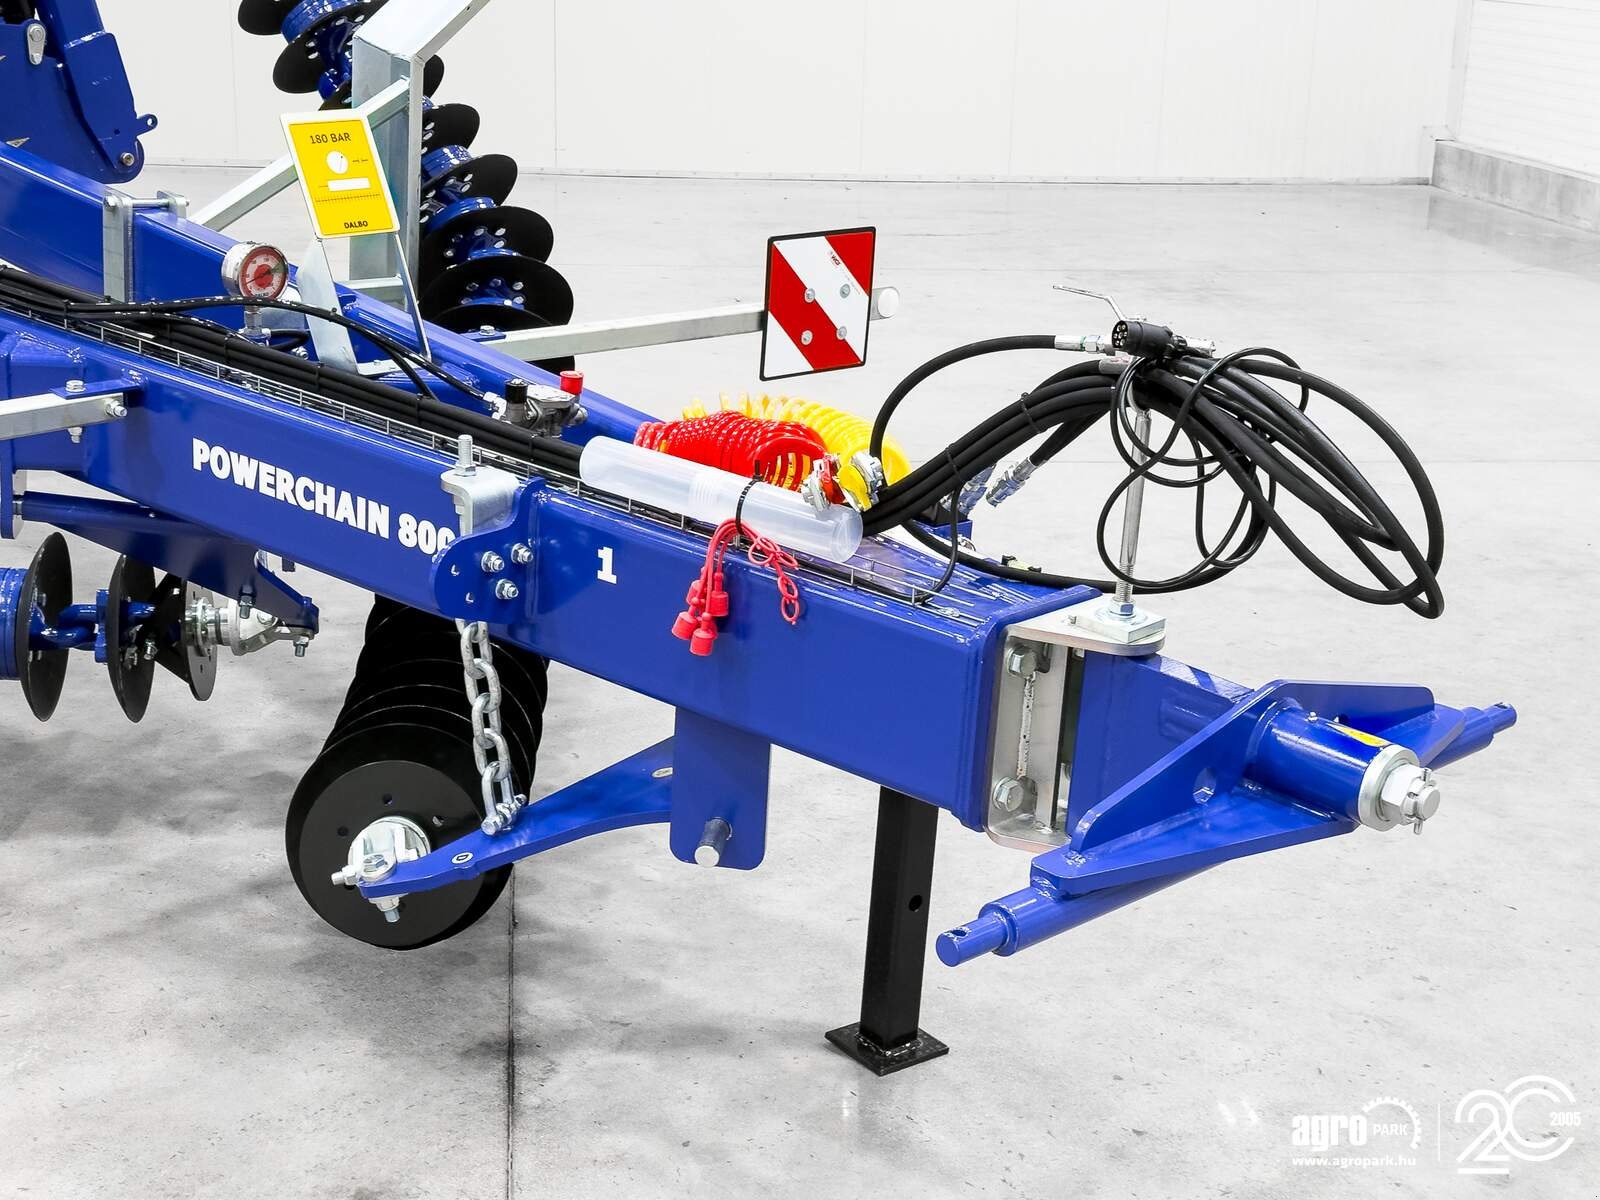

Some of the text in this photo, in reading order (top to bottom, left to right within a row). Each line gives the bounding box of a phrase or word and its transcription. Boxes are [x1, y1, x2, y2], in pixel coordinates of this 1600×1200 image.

[310, 132, 351, 144] 180 BAR
[344, 220, 368, 229] DALBO
[192, 438, 389, 539] POWERCHAIN
[597, 546, 617, 584] 1
